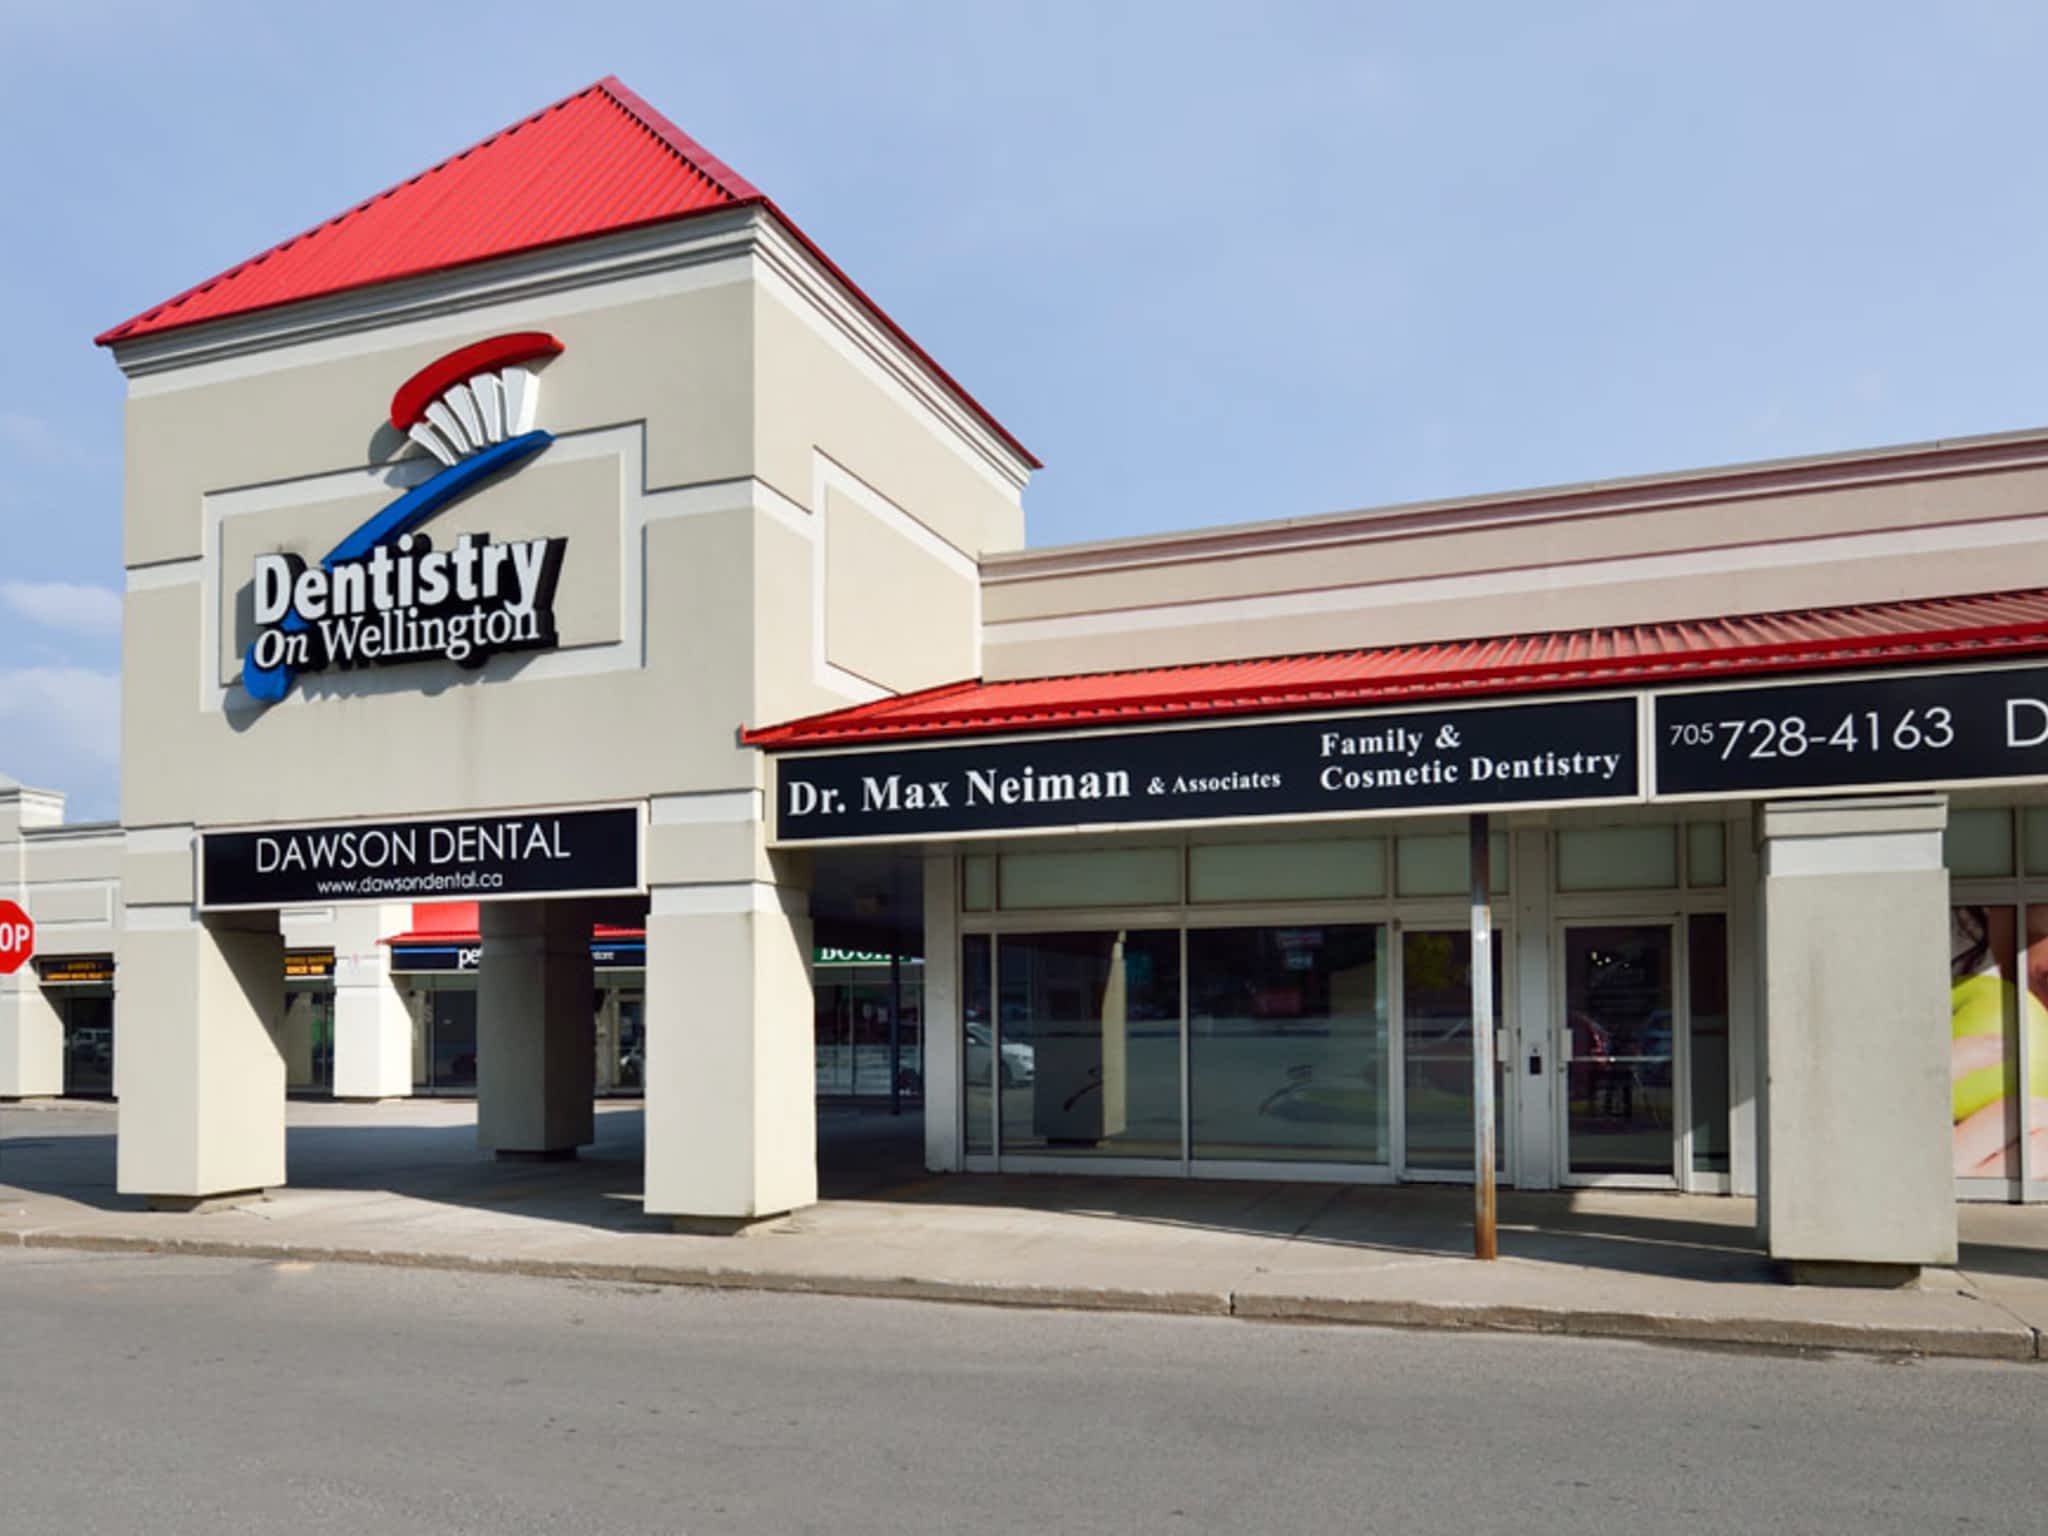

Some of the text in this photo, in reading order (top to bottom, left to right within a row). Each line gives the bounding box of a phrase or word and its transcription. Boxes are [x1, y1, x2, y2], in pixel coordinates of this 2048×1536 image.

[255, 534, 548, 624] Dentistry
[255, 604, 541, 668] On Wellington
[1321, 724, 1461, 757] Family &
[1669, 706, 1954, 761] 705 728-4163
[787, 765, 1281, 816] Dr. Max Neiman & Associates
[1320, 752, 1620, 790] Cosmetic Dentistry
[256, 821, 571, 873] DAWSON DENTAL
[317, 871, 503, 894] www.dawsondental.ca
[0, 922, 30, 952] OP
